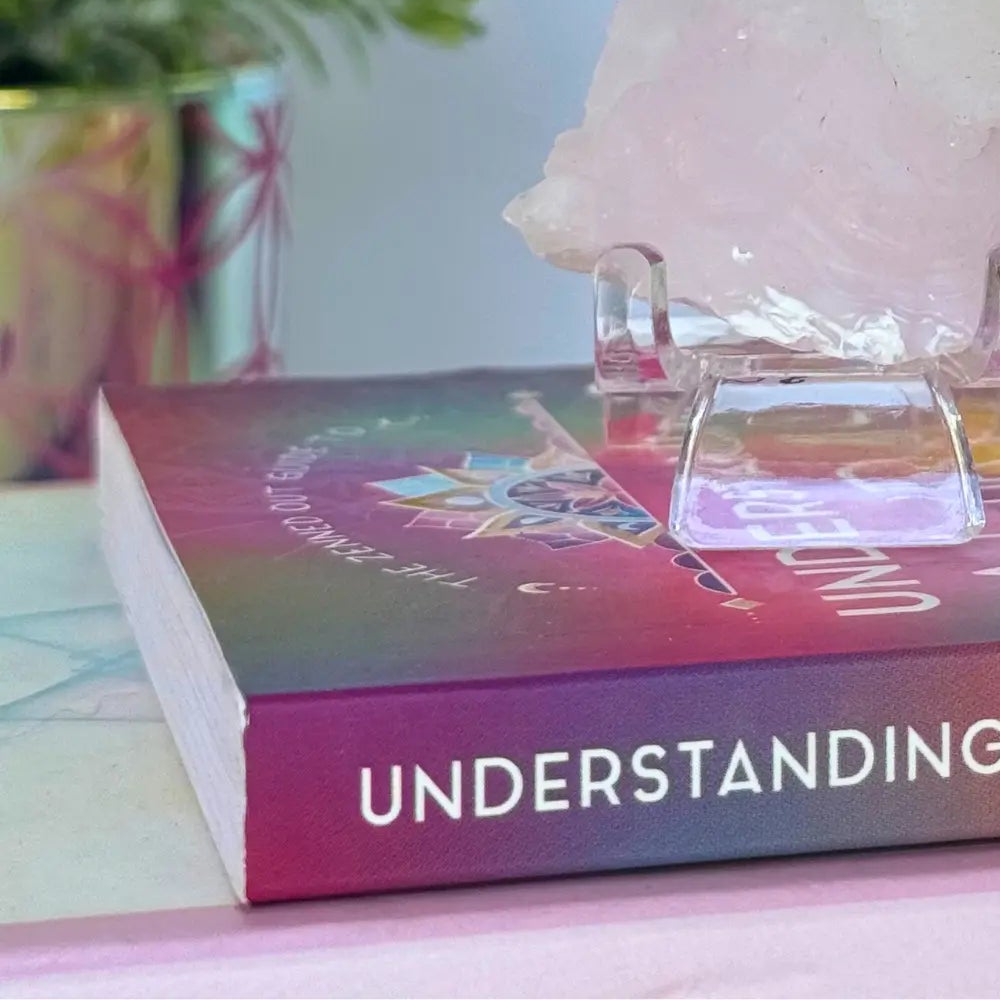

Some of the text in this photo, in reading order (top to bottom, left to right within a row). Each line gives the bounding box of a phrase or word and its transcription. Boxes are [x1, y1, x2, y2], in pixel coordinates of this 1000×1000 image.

[264, 484, 351, 512] OUT
[281, 515, 395, 563] ZENNED
[380, 562, 478, 588] THE
